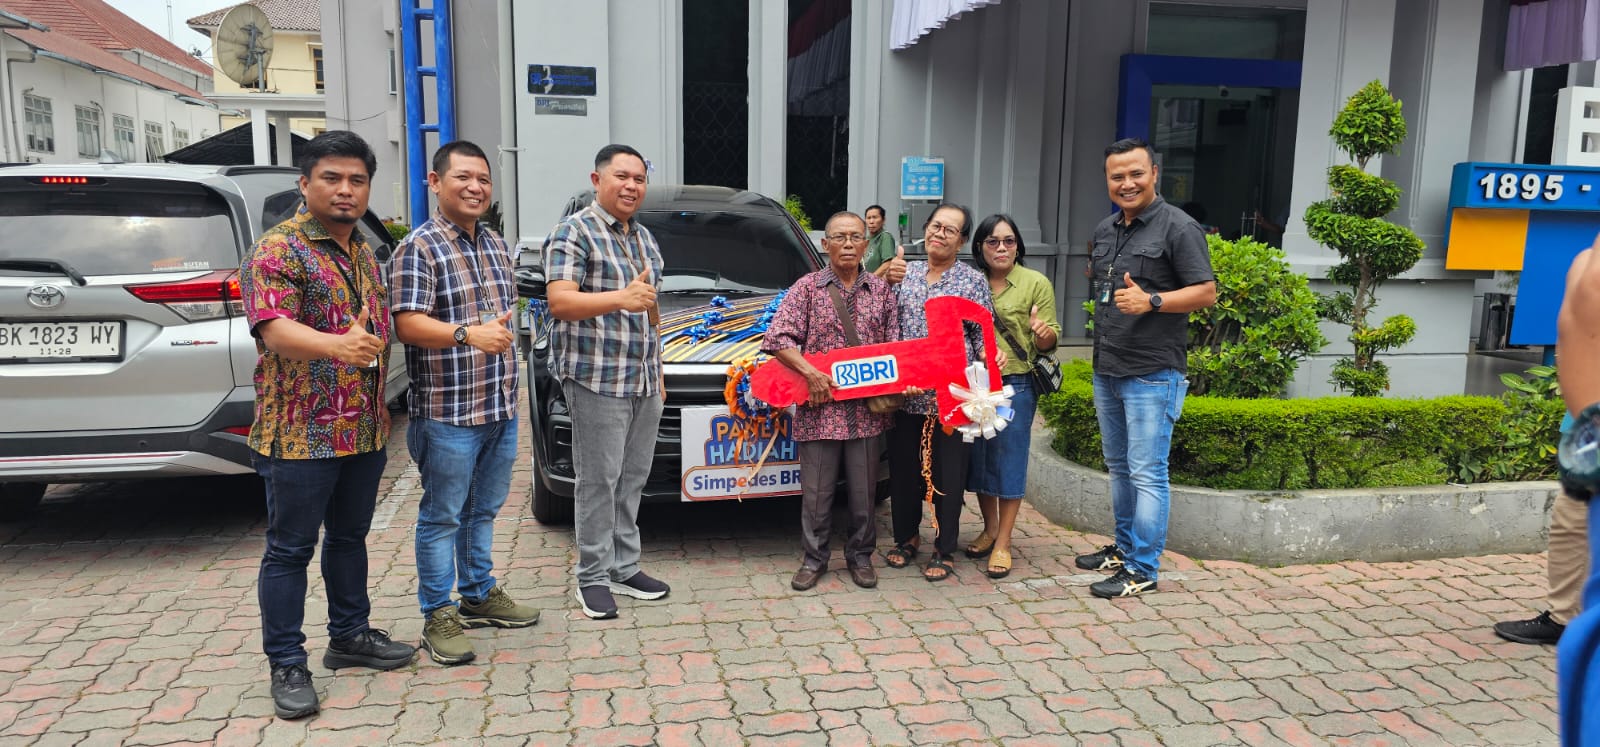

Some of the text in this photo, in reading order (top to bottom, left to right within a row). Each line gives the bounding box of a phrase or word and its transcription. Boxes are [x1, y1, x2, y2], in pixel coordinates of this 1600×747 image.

[1480, 172, 1564, 201] 1895
[0, 325, 115, 346] BK 1823 WY
[859, 360, 895, 382] BRI
[716, 417, 788, 442] PANEN
[709, 441, 795, 465] HADIAH
[693, 469, 801, 492] Simpedes BR
